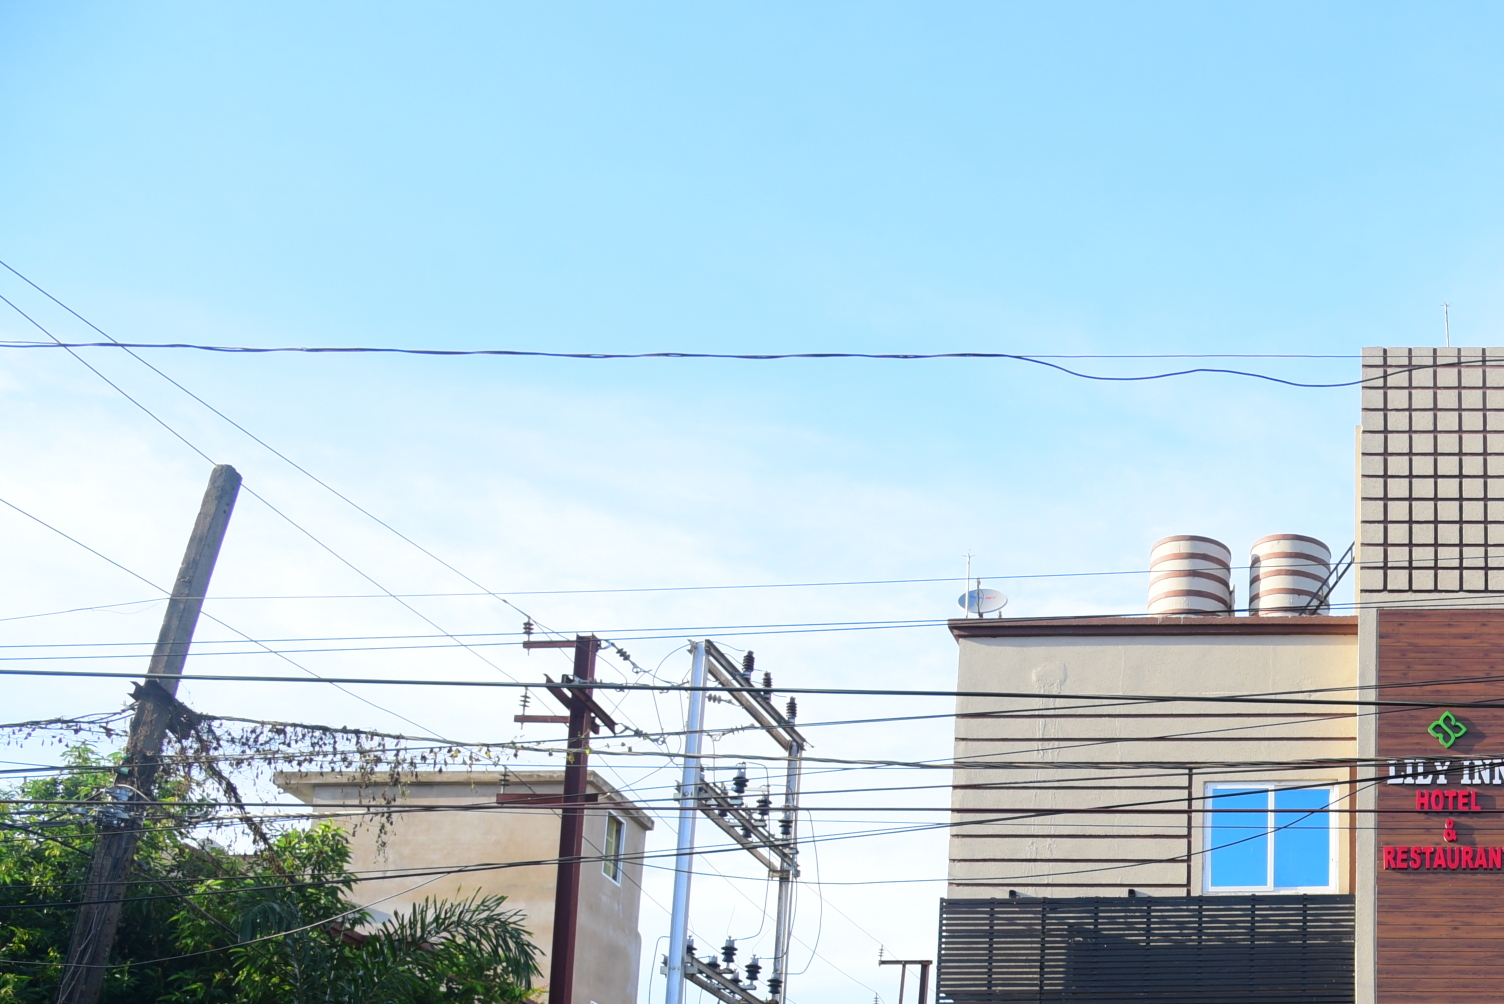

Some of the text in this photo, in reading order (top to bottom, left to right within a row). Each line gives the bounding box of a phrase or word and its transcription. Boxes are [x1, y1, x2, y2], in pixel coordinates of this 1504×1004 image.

[1387, 759, 1450, 785] LILY
[1416, 790, 1481, 811] HOTEL
[1443, 818, 1457, 842] &
